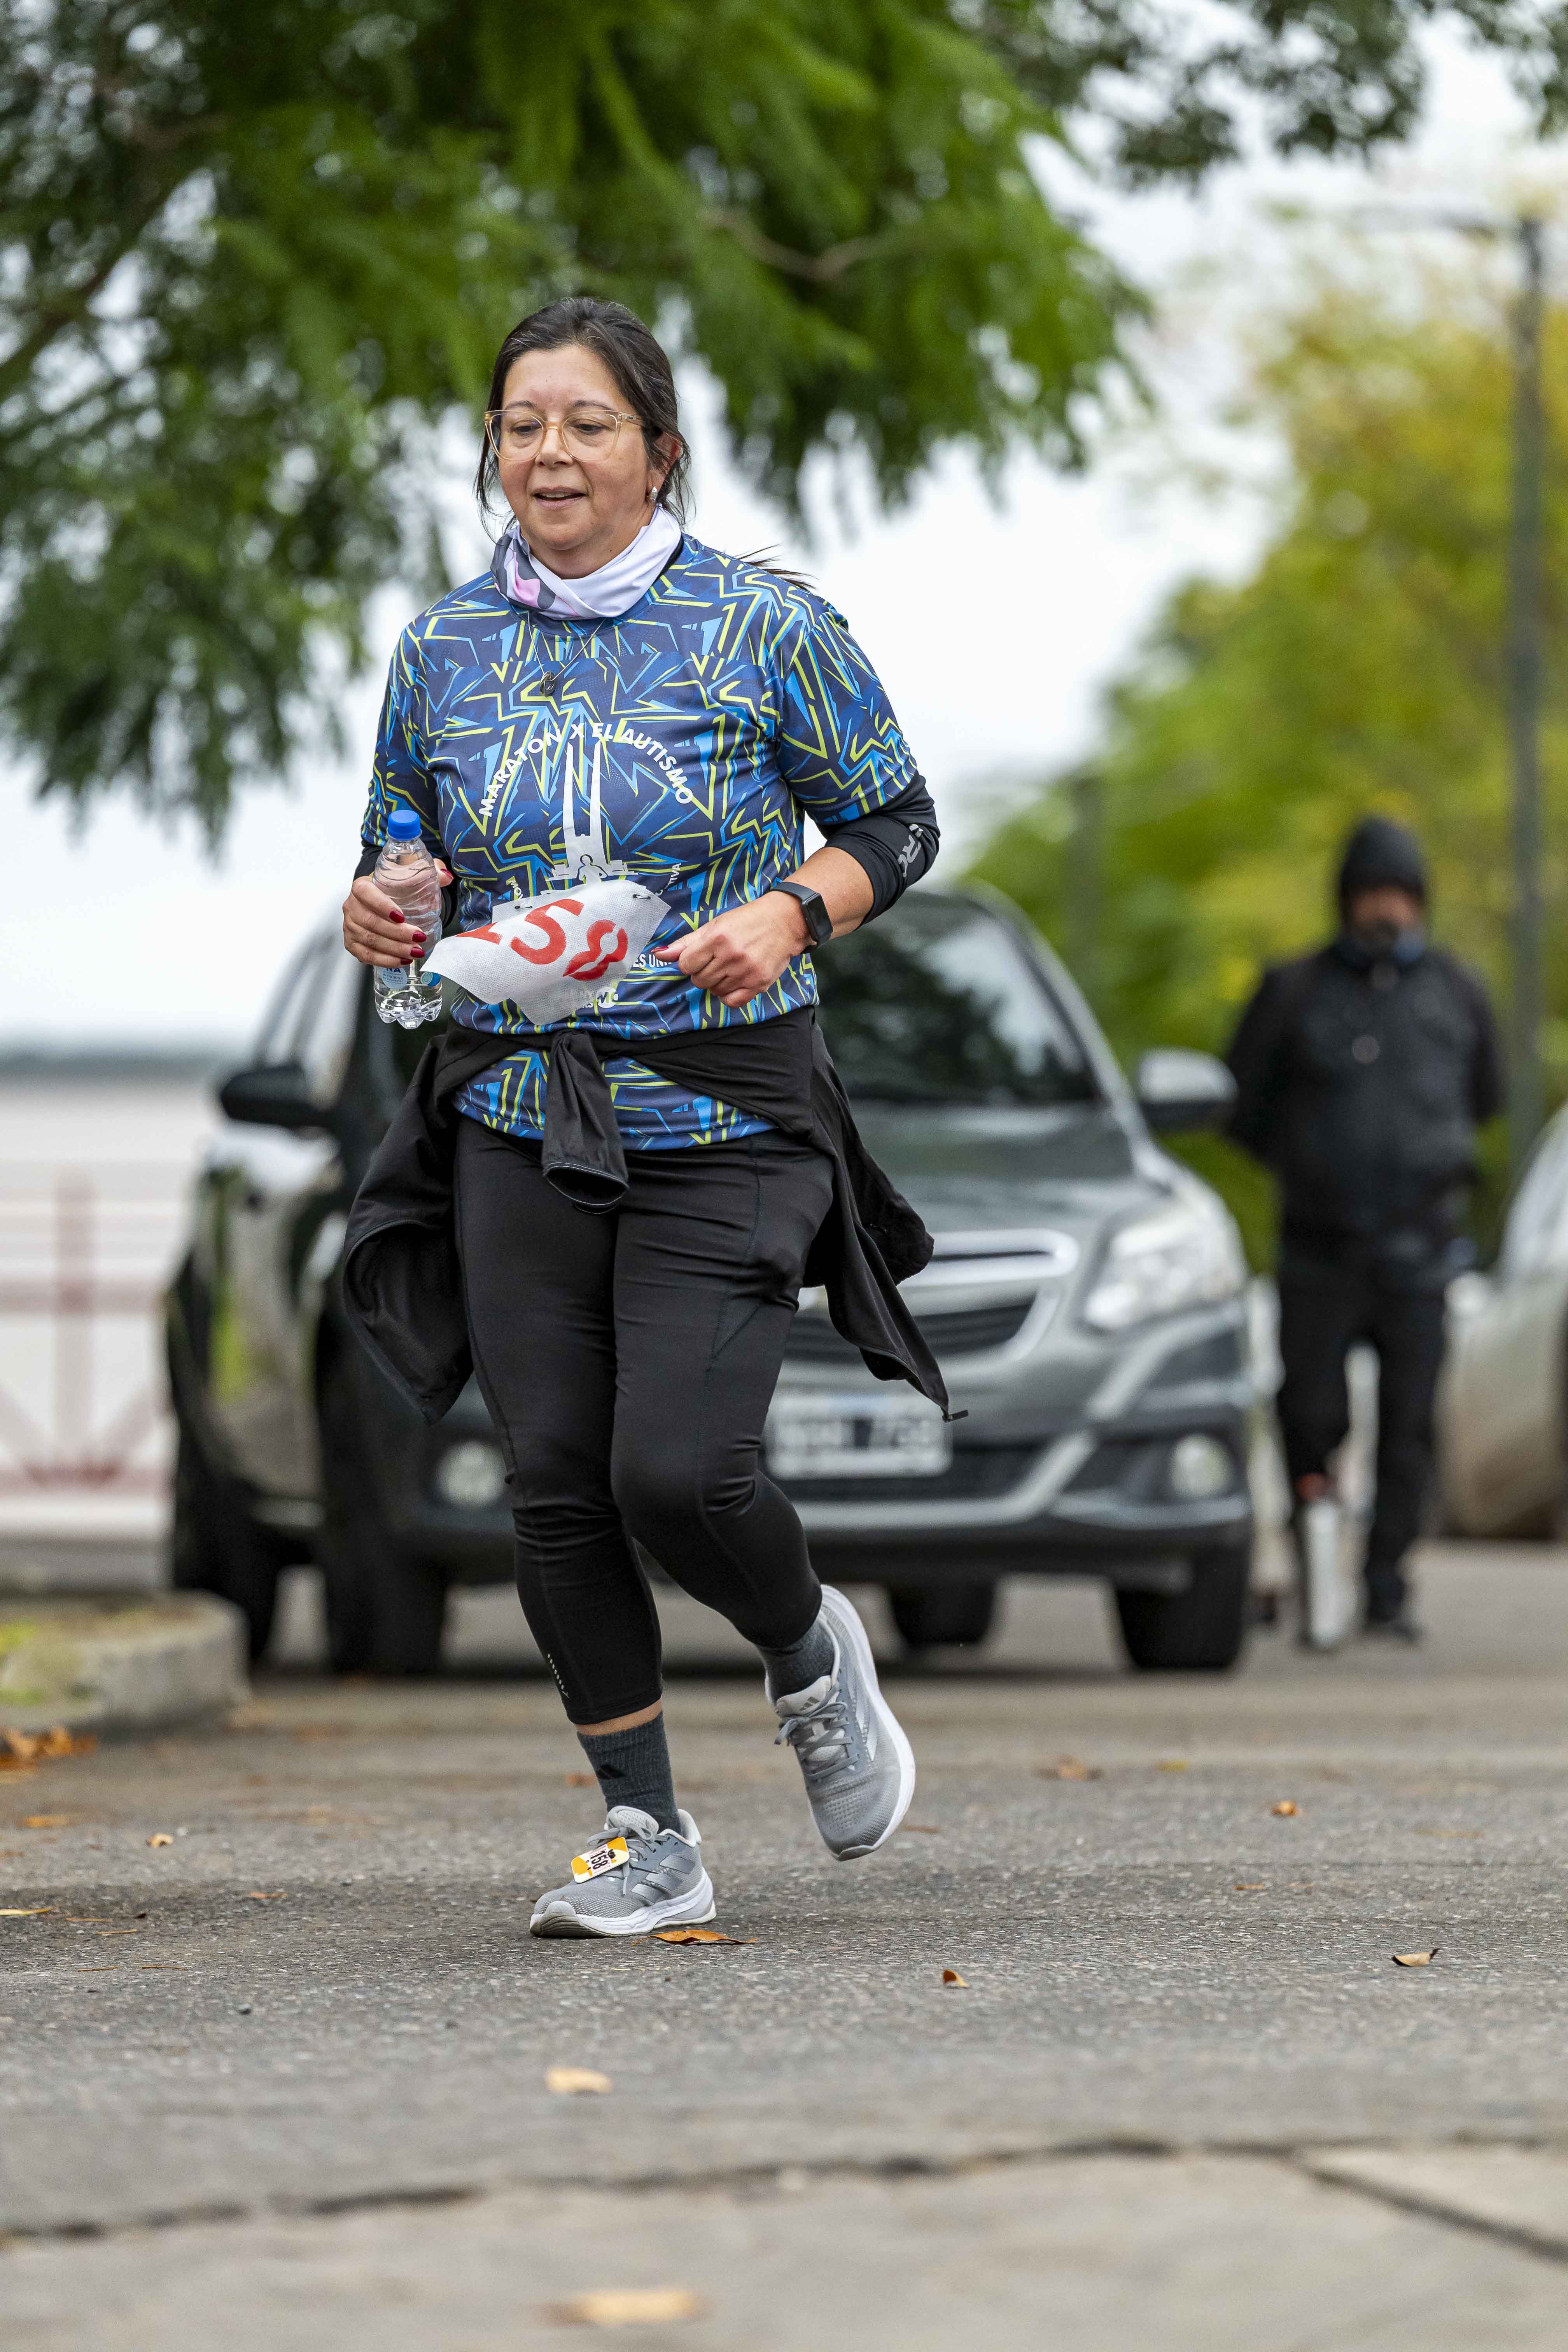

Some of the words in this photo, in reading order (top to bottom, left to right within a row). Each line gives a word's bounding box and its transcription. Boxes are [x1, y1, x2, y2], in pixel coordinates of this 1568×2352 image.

[478, 728, 563, 817] MARATÓN
[569, 723, 584, 739] X
[592, 722, 614, 740] EL
[619, 728, 693, 804] AUTISMO
[590, 1850, 608, 1870] 158
